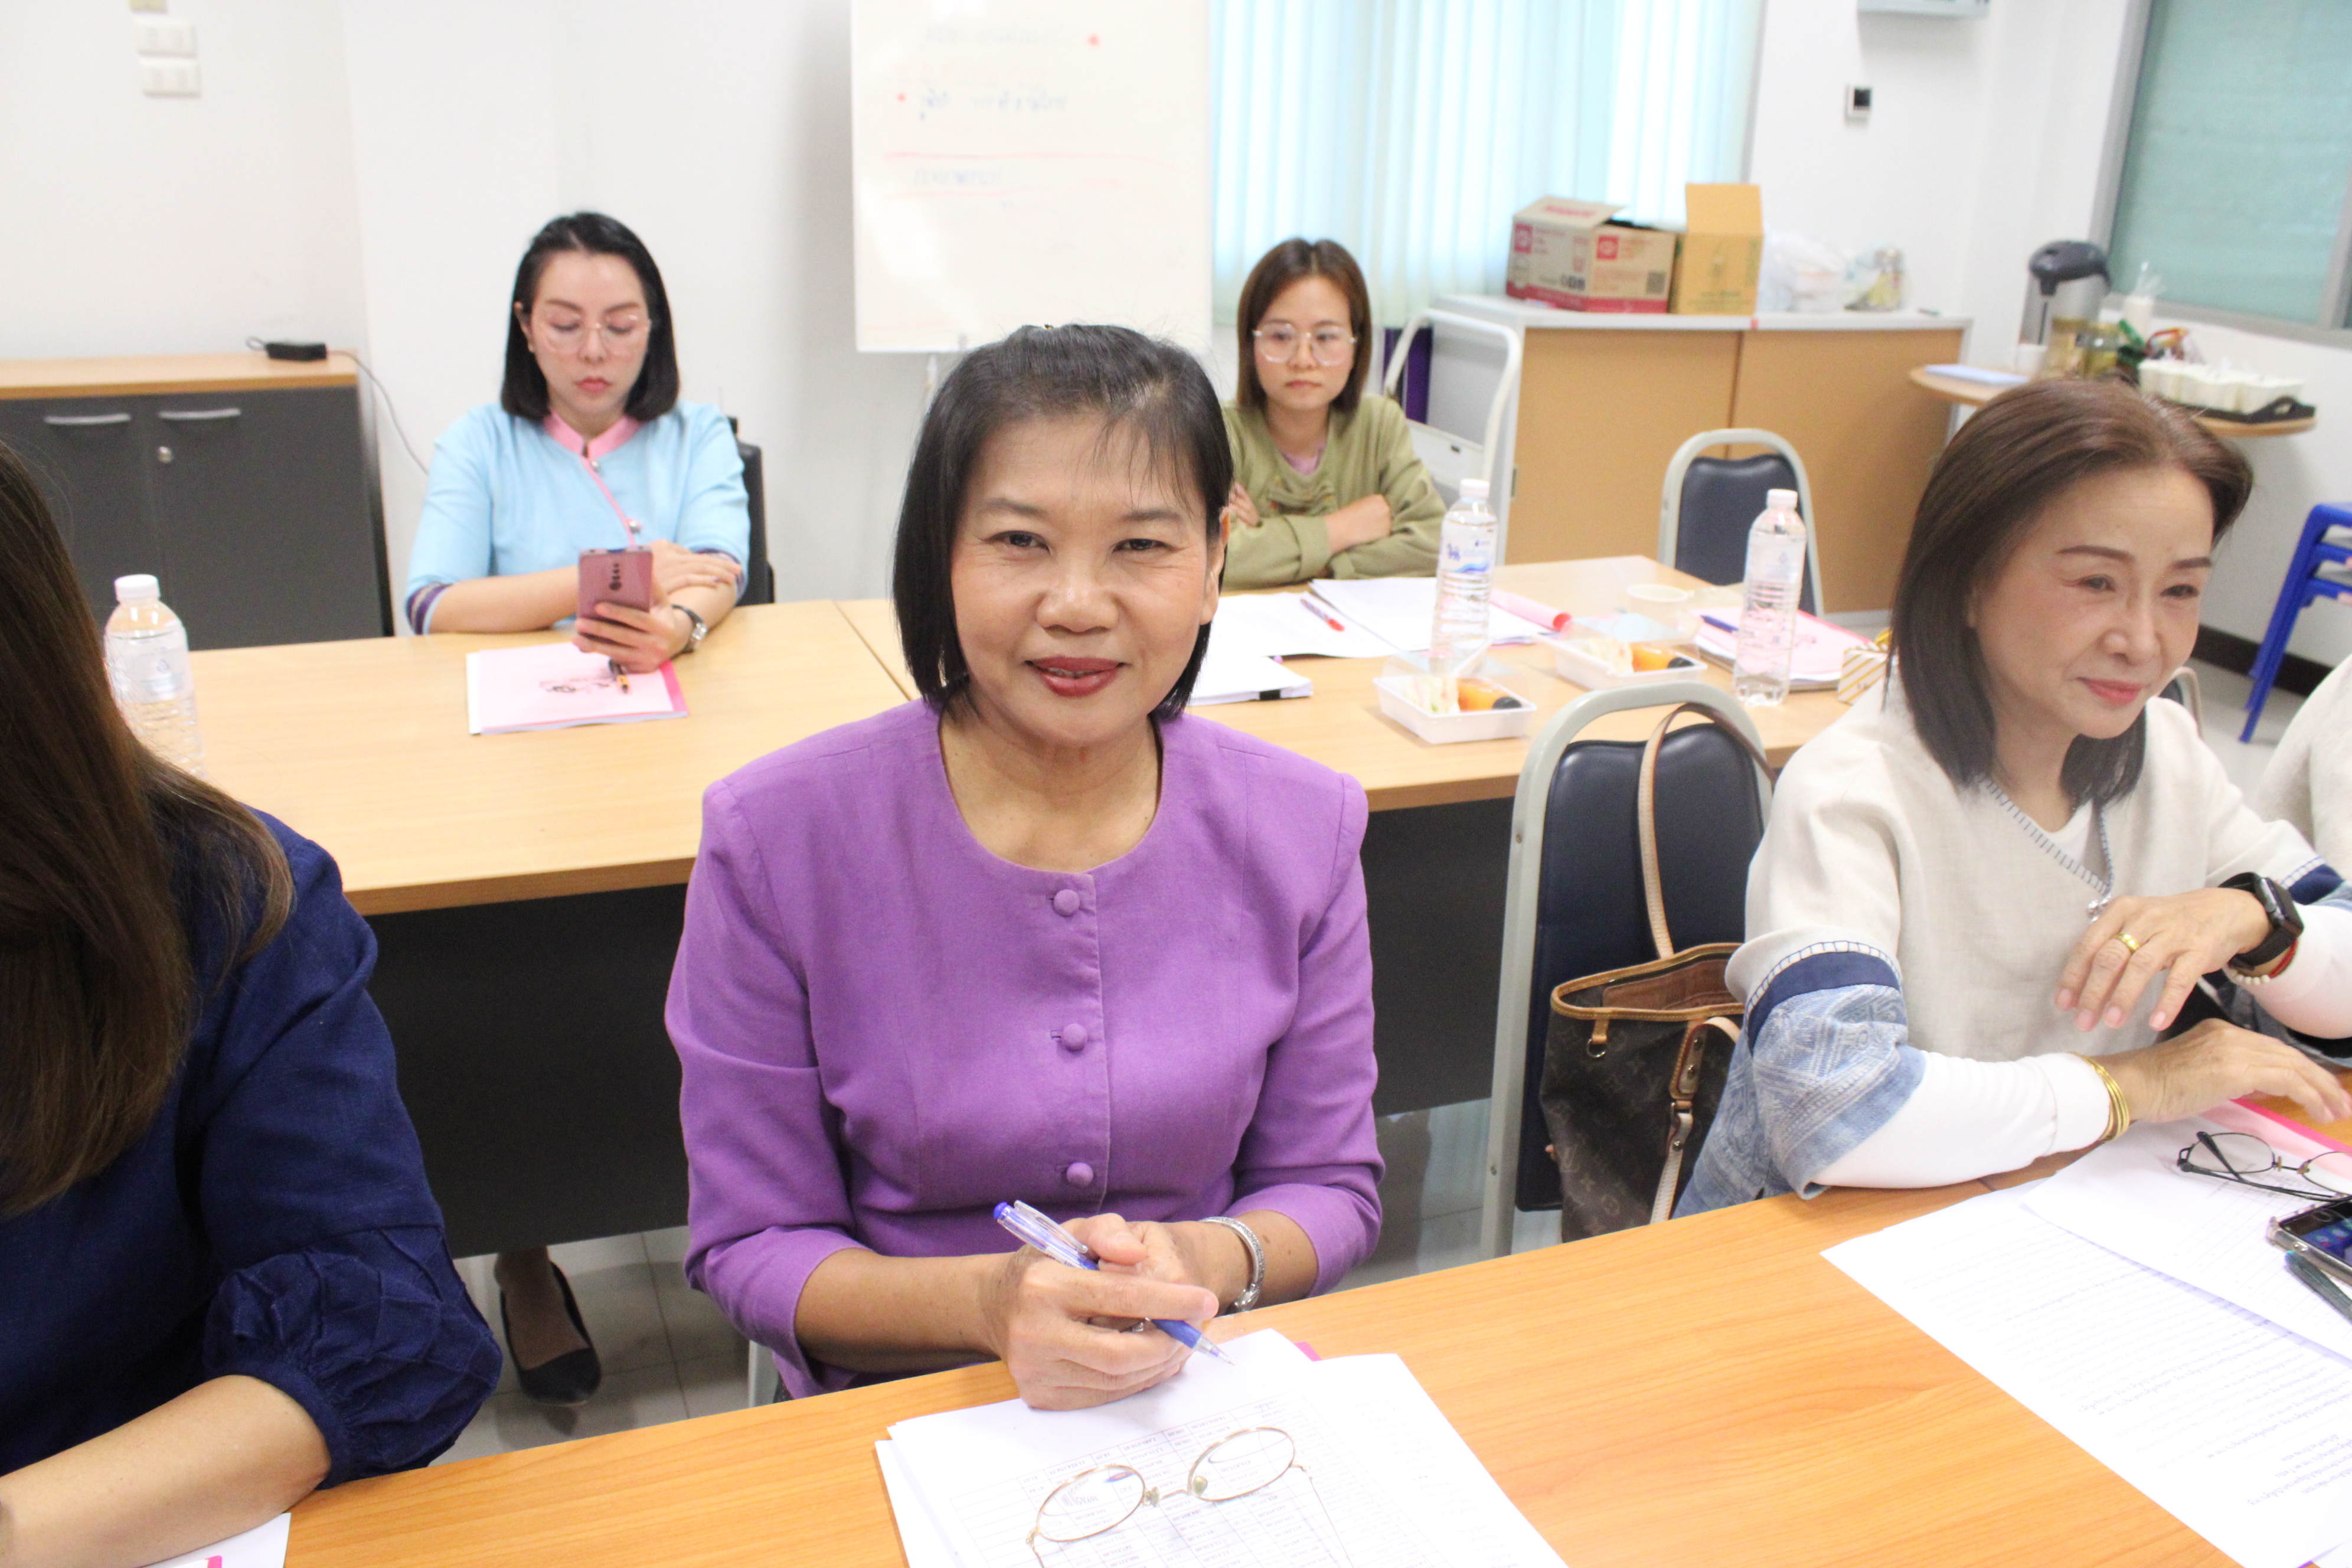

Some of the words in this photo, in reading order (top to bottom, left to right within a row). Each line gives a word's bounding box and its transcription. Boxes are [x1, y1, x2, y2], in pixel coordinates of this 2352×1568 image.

[1167, 1428, 1184, 1437] 100.00
[1174, 1438, 1191, 1446] 100.00
[1095, 1452, 1110, 1460] 18.35
[1048, 1459, 1084, 1475] 11,924,154.55
[1220, 1459, 1251, 1473] 416,835.00
[1164, 1500, 1191, 1511] 11,500.00
[1257, 1504, 1285, 1518] 443,435.00
[1179, 1519, 1207, 1531] 70,795.00
[1095, 1534, 1125, 1547] 772,510.00
[1102, 1544, 1132, 1557] 347,510.00
[1203, 1550, 1229, 1563] 12,110.00
